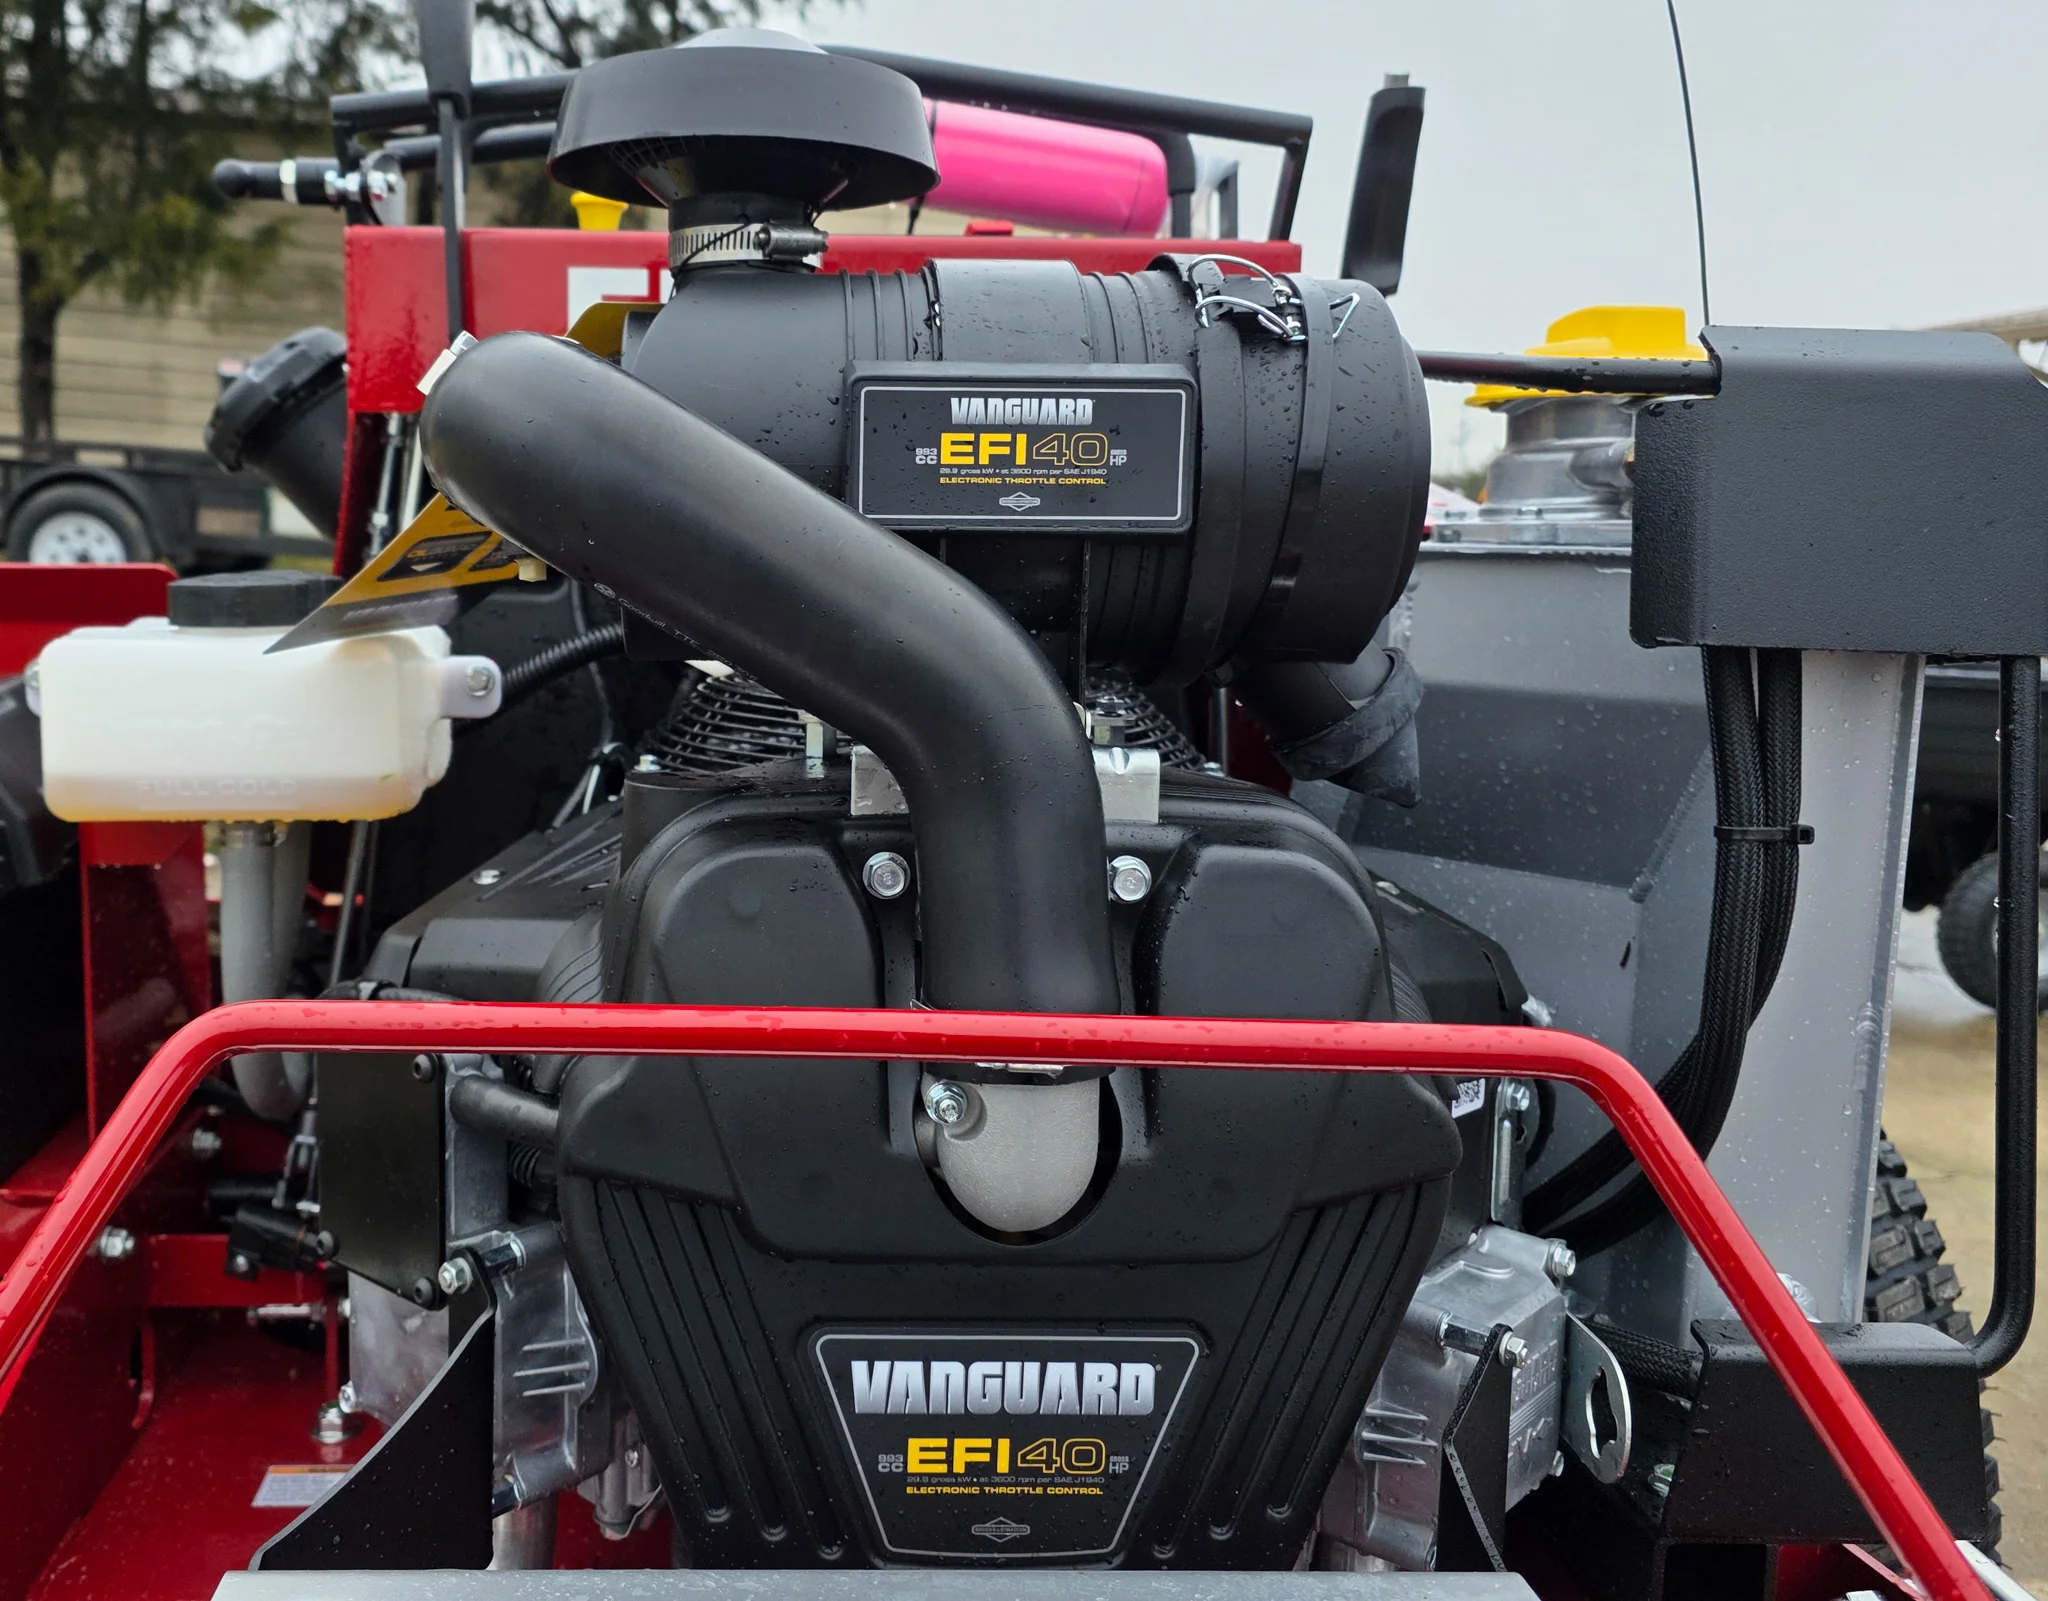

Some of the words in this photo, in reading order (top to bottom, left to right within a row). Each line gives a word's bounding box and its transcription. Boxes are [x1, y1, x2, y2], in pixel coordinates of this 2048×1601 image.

[950, 397, 1093, 425] VANGUARD
[915, 447, 938, 456] 993
[915, 455, 938, 465] CC
[1109, 455, 1128, 466] HP
[1004, 477, 1056, 485] THROTTLE
[1058, 477, 1107, 485] CONTROL
[618, 597, 667, 629] Goodwill
[135, 779, 210, 796] FULL
[217, 778, 299, 796] COLD
[851, 1360, 1156, 1416] VANGUARD
[877, 1462, 904, 1473] CC
[1108, 1462, 1129, 1474] HP
[906, 1486, 980, 1494] ELECTRONIC
[983, 1486, 1044, 1494] THROTTLE
[1046, 1486, 1104, 1495] CONTROL
